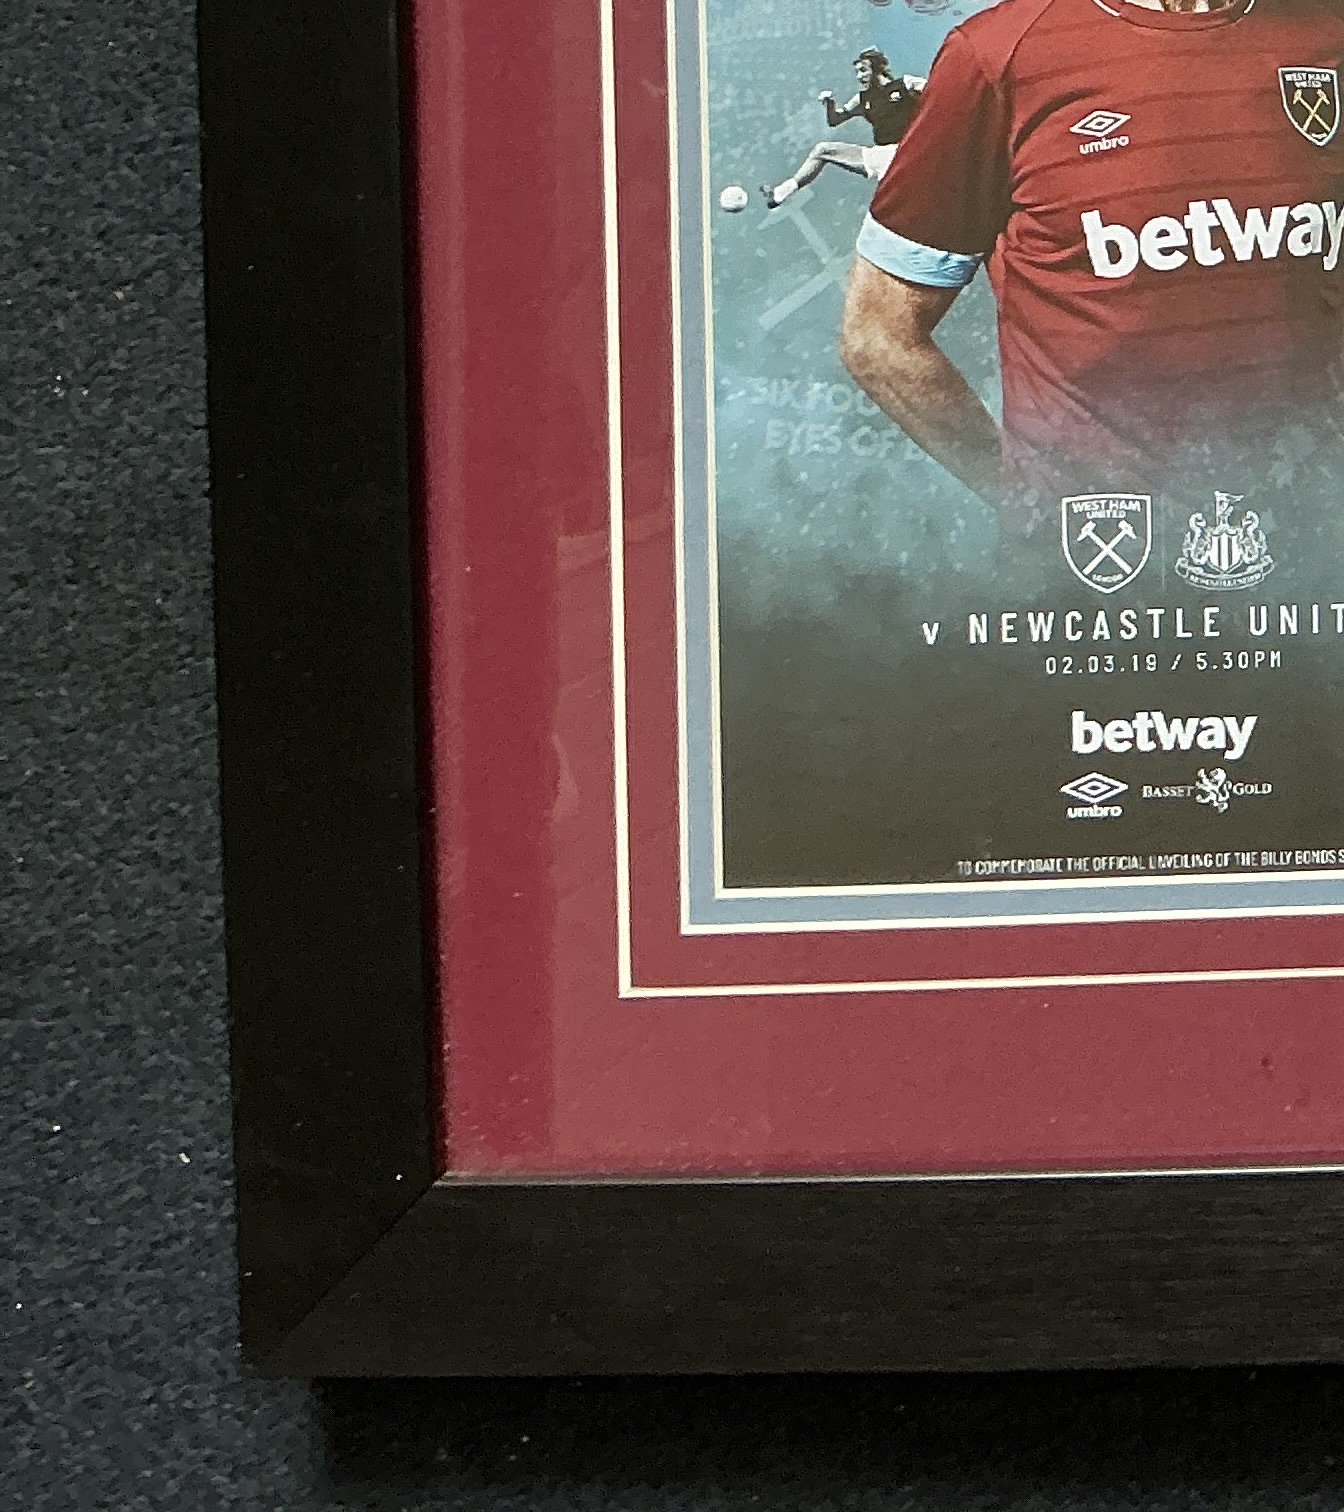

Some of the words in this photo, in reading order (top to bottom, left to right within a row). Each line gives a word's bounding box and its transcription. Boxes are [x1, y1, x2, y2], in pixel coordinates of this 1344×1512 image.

[1079, 135, 1130, 154] umbro
[1071, 499, 1107, 514] WEST
[1111, 499, 1142, 513] HAM
[968, 605, 1221, 645] NEWCASTLE
[1044, 653, 1159, 675] 02.03.19
[1169, 652, 1183, 672] /
[1195, 650, 1283, 671] 5.30PM
[1071, 710, 1259, 760] betway
[1142, 784, 1195, 799] BASSET
[1232, 782, 1272, 796] GOLD
[1066, 804, 1123, 818] umbro
[957, 859, 973, 876] TO
[975, 856, 1064, 875] COMMEMORATE
[1066, 856, 1090, 873] THE
[1092, 854, 1146, 872] OFFICIAL
[1215, 852, 1232, 868] OF
[1234, 850, 1259, 867] THE
[1261, 849, 1292, 867] BILLY
[1294, 848, 1337, 866] BONDS
